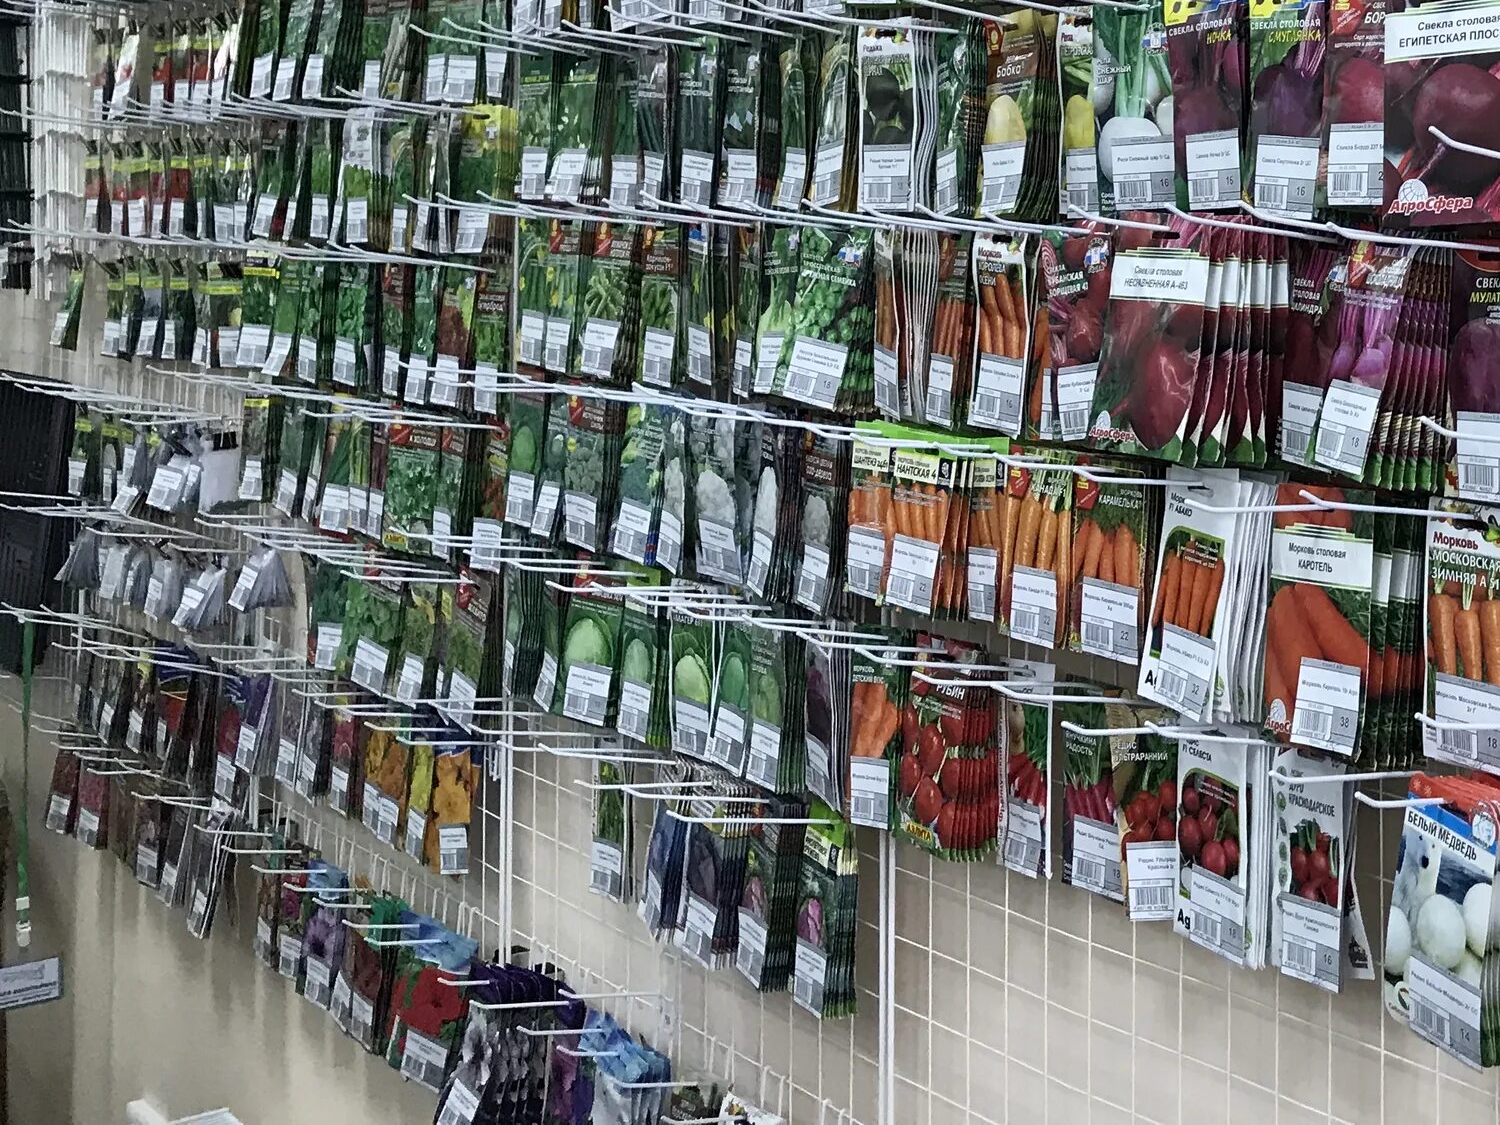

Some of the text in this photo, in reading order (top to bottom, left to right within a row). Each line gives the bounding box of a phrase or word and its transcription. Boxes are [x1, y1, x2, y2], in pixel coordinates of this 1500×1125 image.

[1250, 21, 1280, 31] СВЕКЛА
[1417, 18, 1454, 31] Свекла
[1399, 32, 1466, 49] ЕГИПЕТСКАЯ
[1388, 196, 1474, 215] АгроСфера
[1288, 543, 1346, 560] Морковь столовая
[1298, 559, 1332, 573] КАРОТЕЛЬ
[1431, 568, 1476, 586] ЗИМНЯЯ
[936, 683, 964, 700] РУБИН
[1339, 715, 1349, 728] 38
[1407, 812, 1477, 861] БЕЛЫЙ МЕДВЕДЬ
